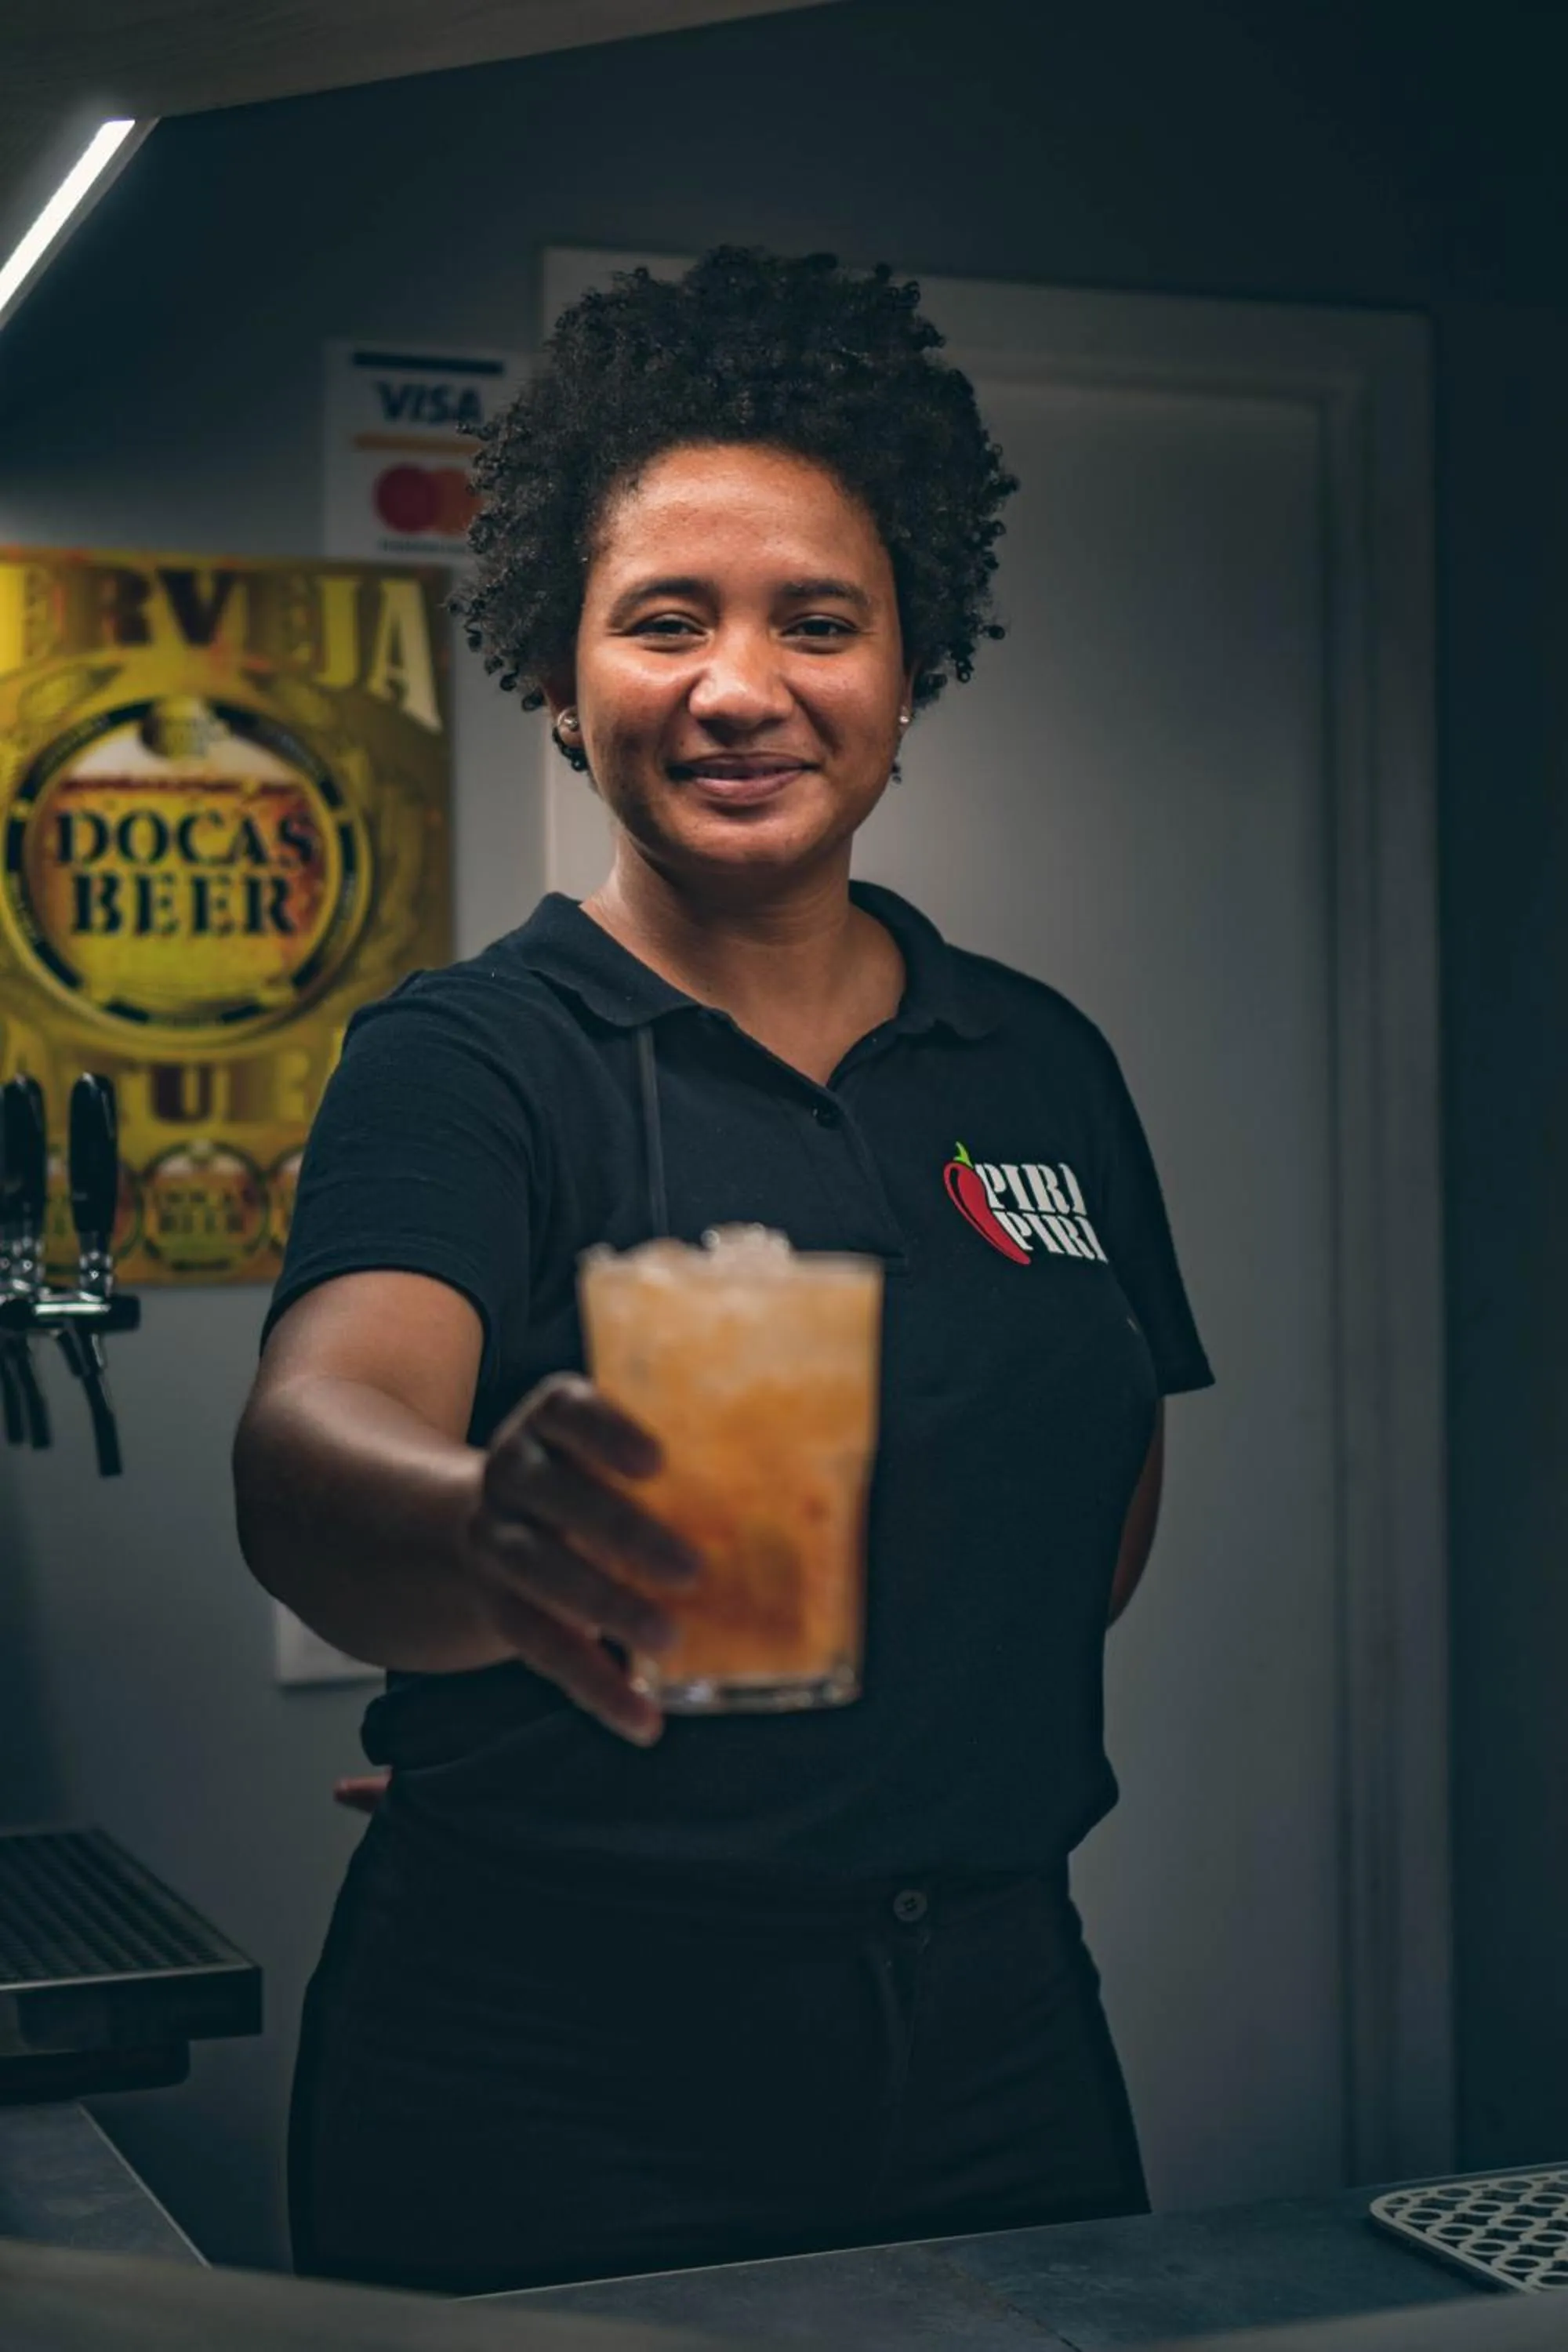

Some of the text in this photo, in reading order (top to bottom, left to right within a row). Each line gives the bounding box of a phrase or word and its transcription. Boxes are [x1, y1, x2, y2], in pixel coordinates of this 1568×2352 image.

[374, 381, 483, 425] VISA
[55, 811, 316, 868] DOCAS
[71, 872, 296, 935] BEER
[975, 1162, 1087, 1216] PIRI
[992, 1210, 1109, 1265] PIRI
